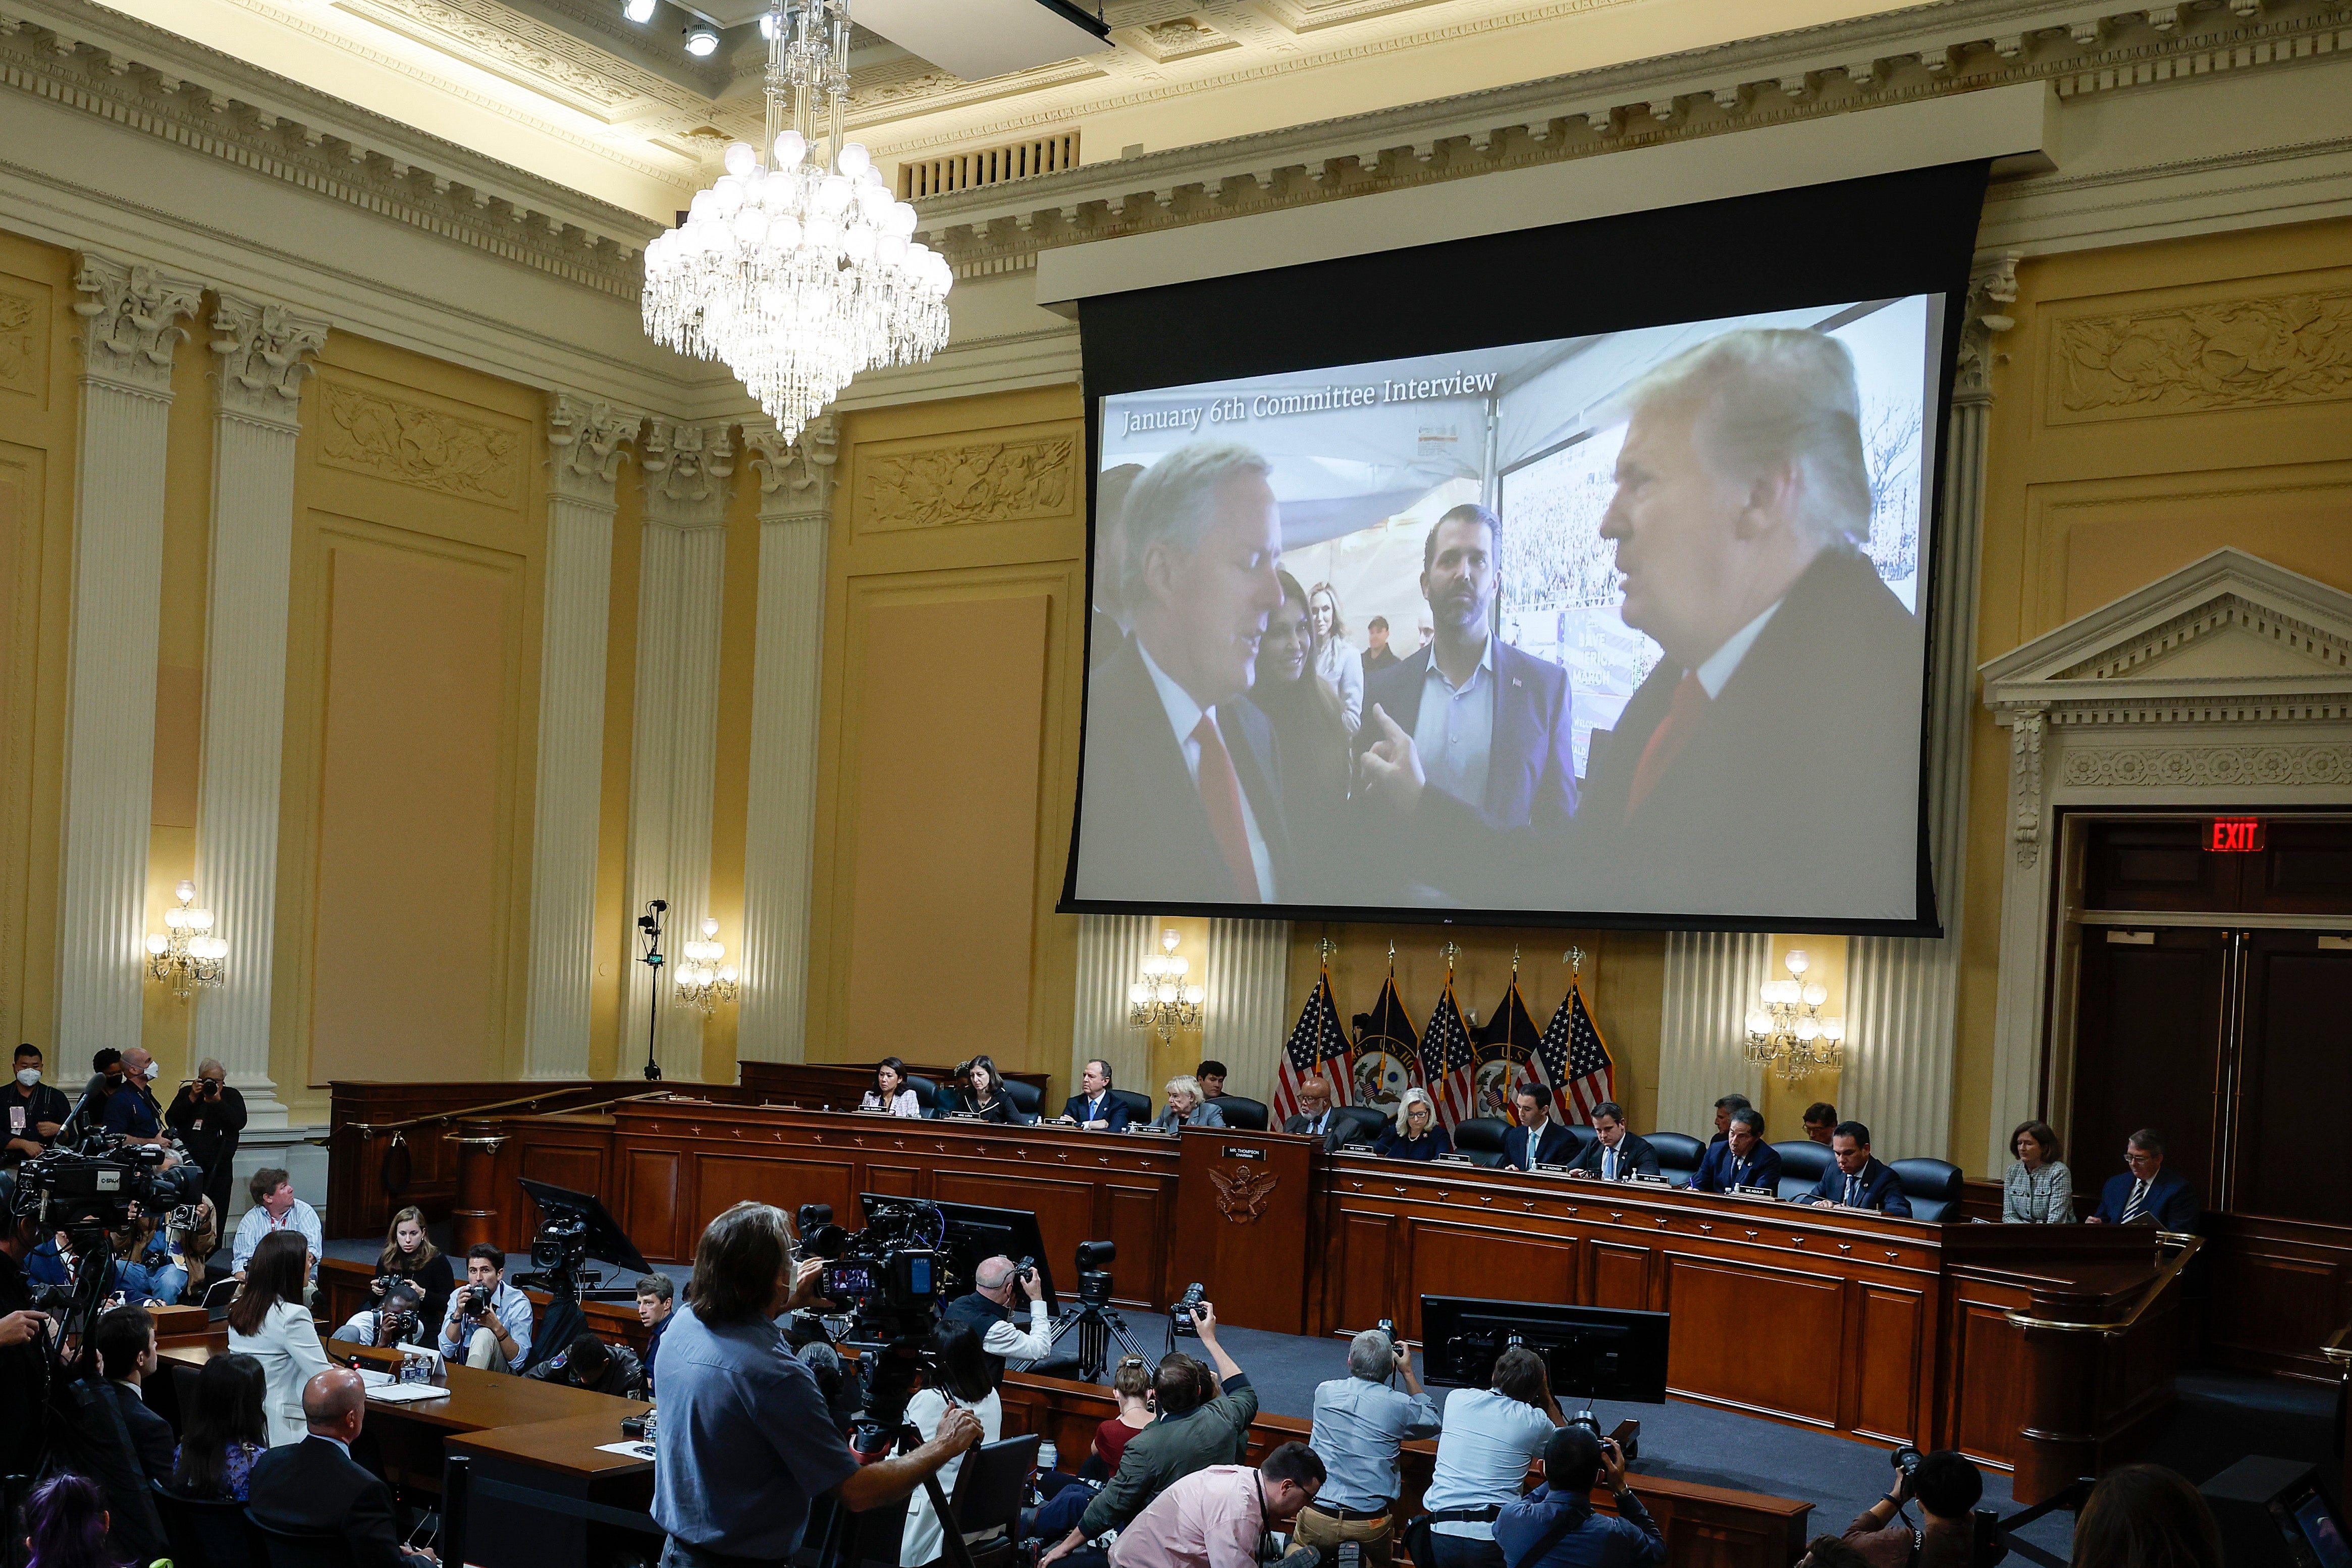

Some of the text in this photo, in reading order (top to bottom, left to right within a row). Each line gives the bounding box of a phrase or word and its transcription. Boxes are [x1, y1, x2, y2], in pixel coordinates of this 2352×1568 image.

[1122, 369, 1499, 436] January 6th Committee Interview
[2213, 823, 2259, 849] EXIT
